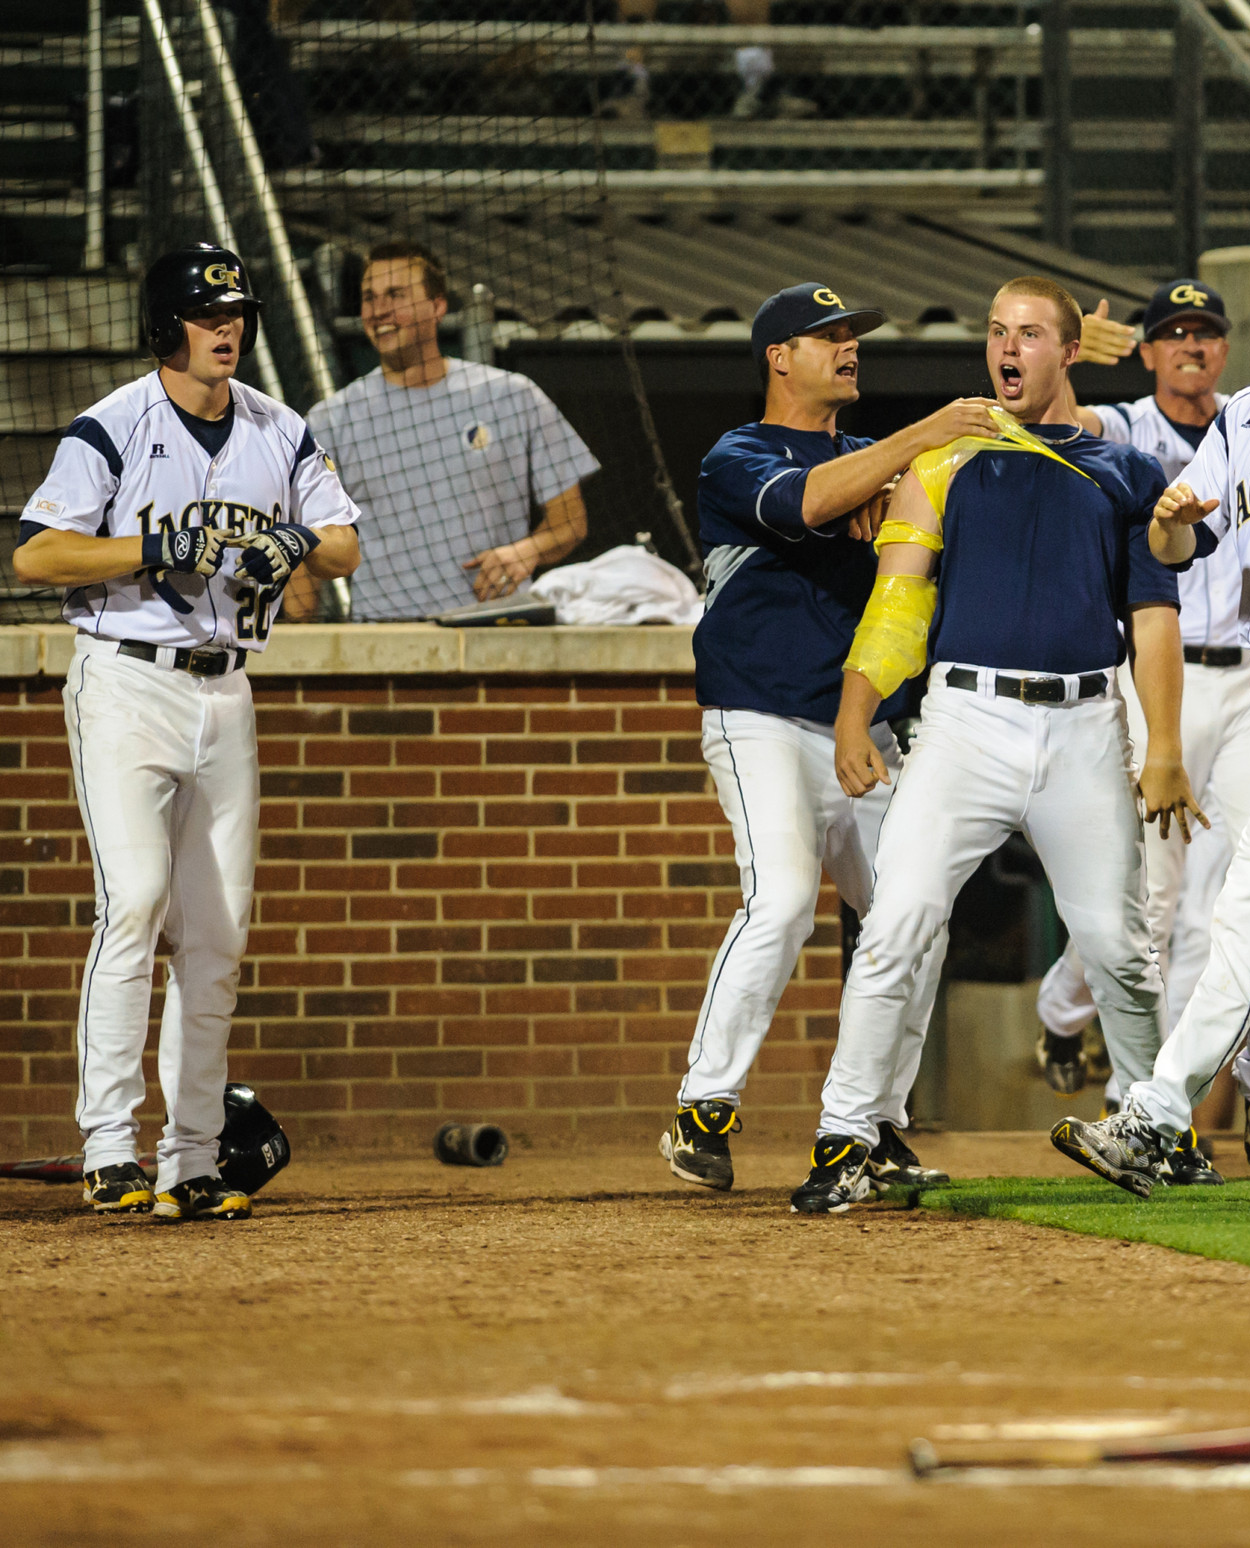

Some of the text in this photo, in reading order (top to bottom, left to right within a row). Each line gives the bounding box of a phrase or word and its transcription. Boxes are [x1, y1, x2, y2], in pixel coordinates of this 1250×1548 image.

[204, 264, 239, 288] GT
[1169, 285, 1208, 307] GT
[152, 444, 164, 454] R
[235, 586, 277, 641] 20
